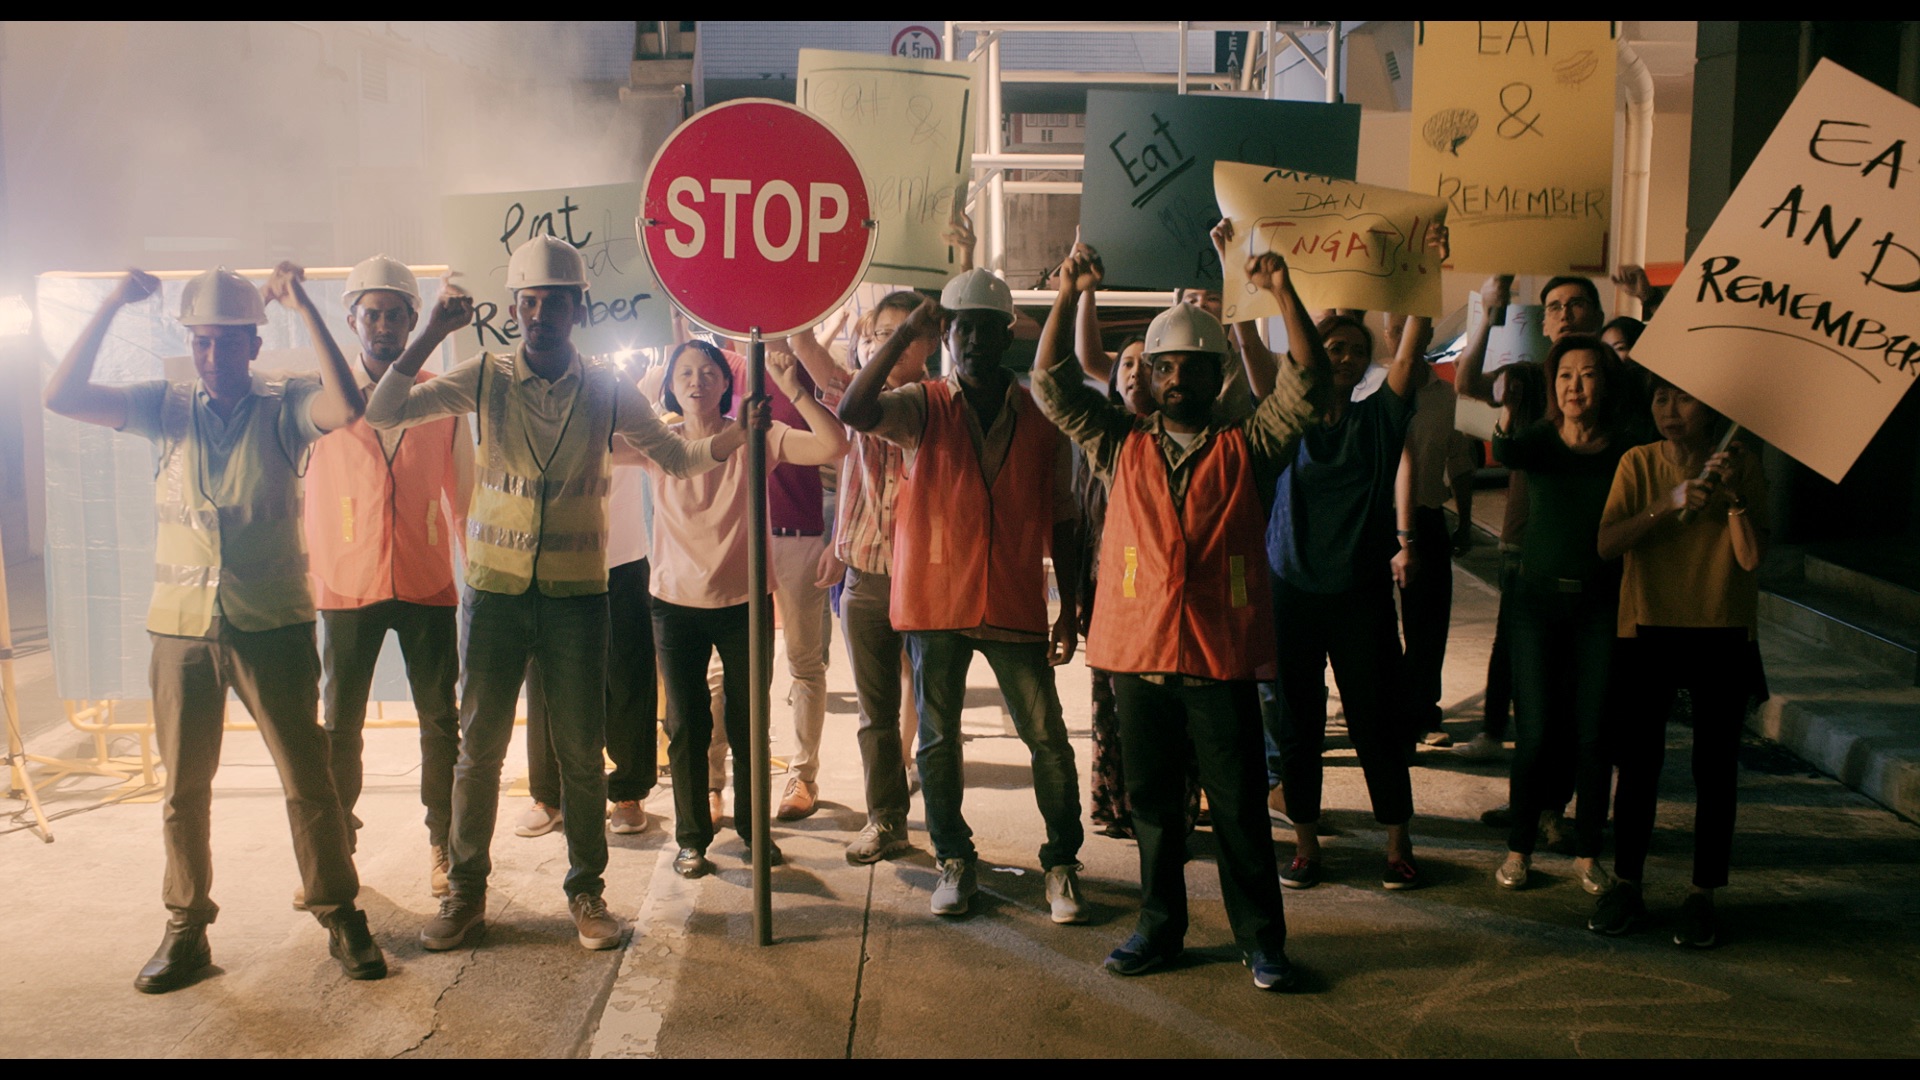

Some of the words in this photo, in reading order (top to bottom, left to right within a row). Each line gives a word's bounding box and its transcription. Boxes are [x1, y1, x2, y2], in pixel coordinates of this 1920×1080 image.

[1497, 82, 1543, 139] &
[1109, 113, 1183, 187] Eat
[1809, 119, 1920, 190] EA
[664, 176, 850, 263] STOP
[1288, 192, 1365, 212] DAN
[1438, 173, 1605, 219] REMEMBER
[1759, 184, 1920, 293] AND
[471, 290, 652, 346] Reber
[1696, 256, 1920, 377] REMEMBER
